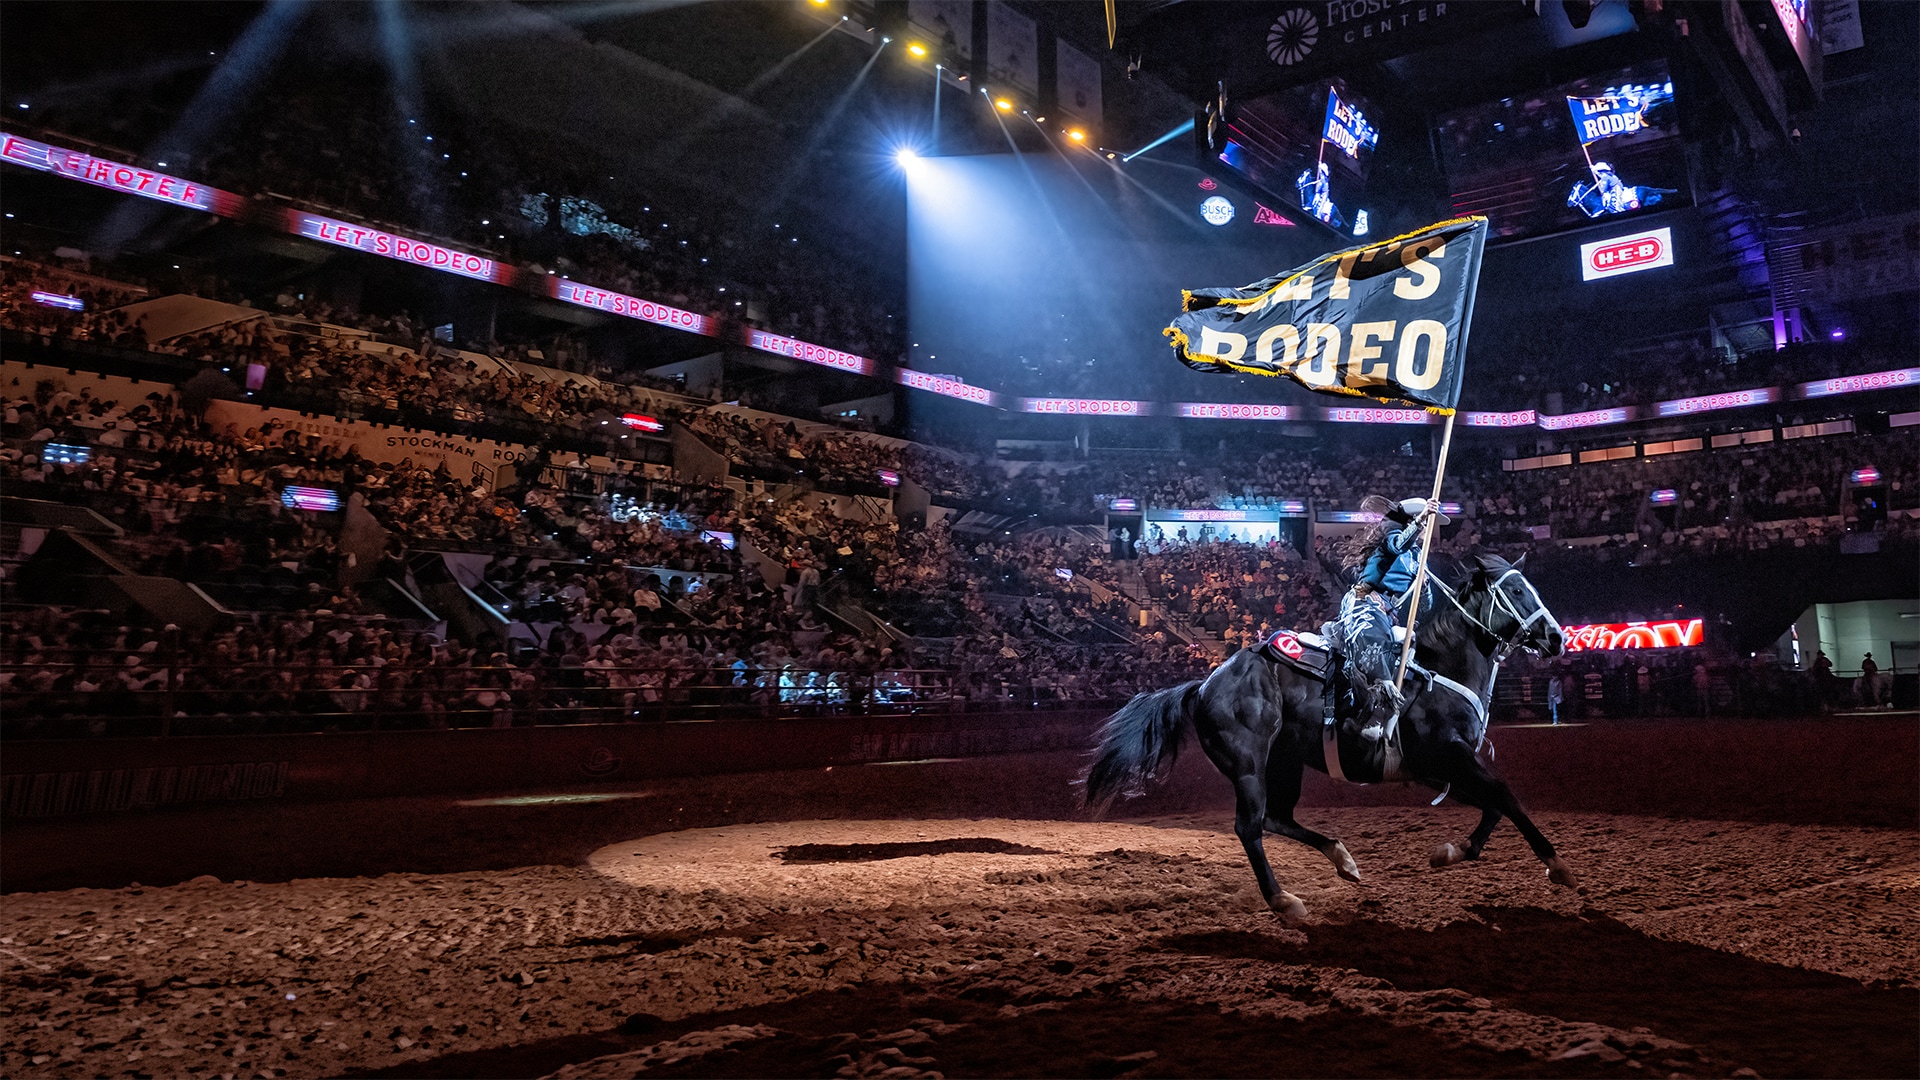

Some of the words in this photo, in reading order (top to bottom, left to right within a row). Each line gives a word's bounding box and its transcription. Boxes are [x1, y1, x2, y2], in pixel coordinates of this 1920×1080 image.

[1344, 3, 1447, 43] CENTER
[1581, 97, 1639, 115] LET'S
[1201, 204, 1235, 217] BUSCH
[319, 222, 391, 253] LET'S
[396, 239, 492, 276] RODEO!
[1597, 243, 1655, 266] H-E-B
[572, 287, 625, 312] LET'S
[629, 299, 701, 328] RODEO!
[762, 336, 803, 357] LET'S
[805, 345, 862, 369] RODEO!
[910, 374, 943, 392] LET'S
[1036, 401, 1076, 413] LET'S
[1079, 401, 1137, 413] RODEO!
[1191, 406, 1229, 417] LET'S
[1231, 406, 1286, 417] RODEO!
[1337, 410, 1373, 421] LET'S
[386, 436, 476, 458] STOCKMAN
